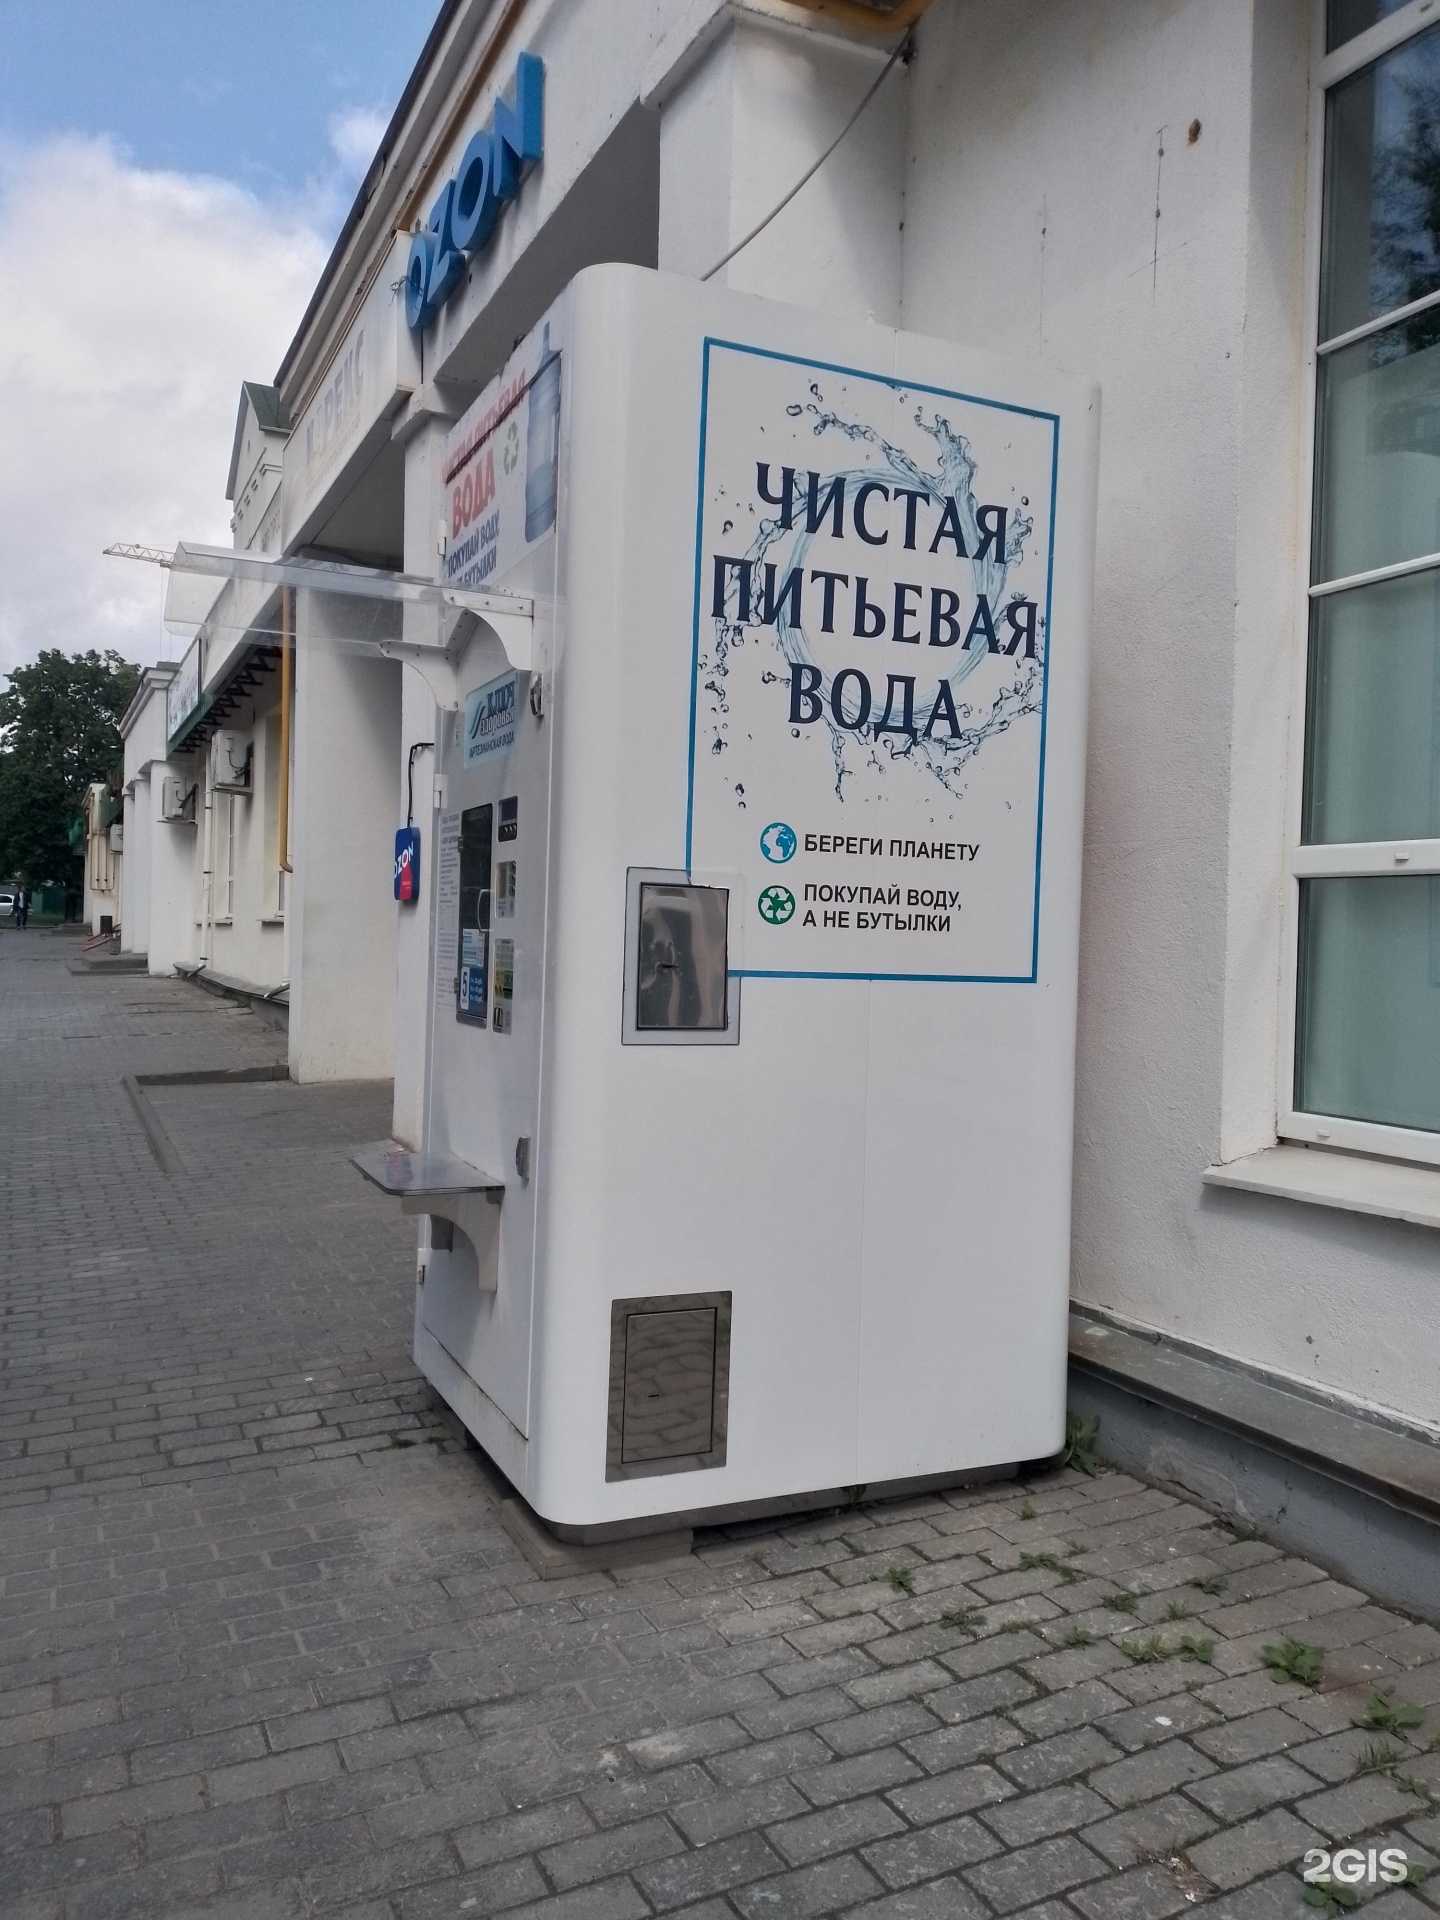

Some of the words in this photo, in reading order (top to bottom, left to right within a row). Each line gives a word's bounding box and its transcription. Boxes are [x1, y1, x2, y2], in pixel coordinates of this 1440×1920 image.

[404, 51, 544, 329] OZON
[452, 447, 496, 540] ВОДА
[755, 461, 1009, 565] ЧИСТАЯ
[447, 527, 480, 579] ПОКУПАЙ
[480, 507, 500, 550] ВОДУ
[711, 554, 1038, 659] ПИТЬЕВАЯ
[787, 662, 963, 743] ВОДА
[804, 833, 884, 856] БЕРЕГИ
[889, 839, 980, 861] ПЛАНЕТУ
[802, 909, 817, 927] А
[823, 911, 850, 929] НЕ
[856, 911, 951, 932] БУТЫЛКИ
[804, 883, 901, 905] ПОКУПАЙ
[907, 888, 963, 912] ВОДУ,
